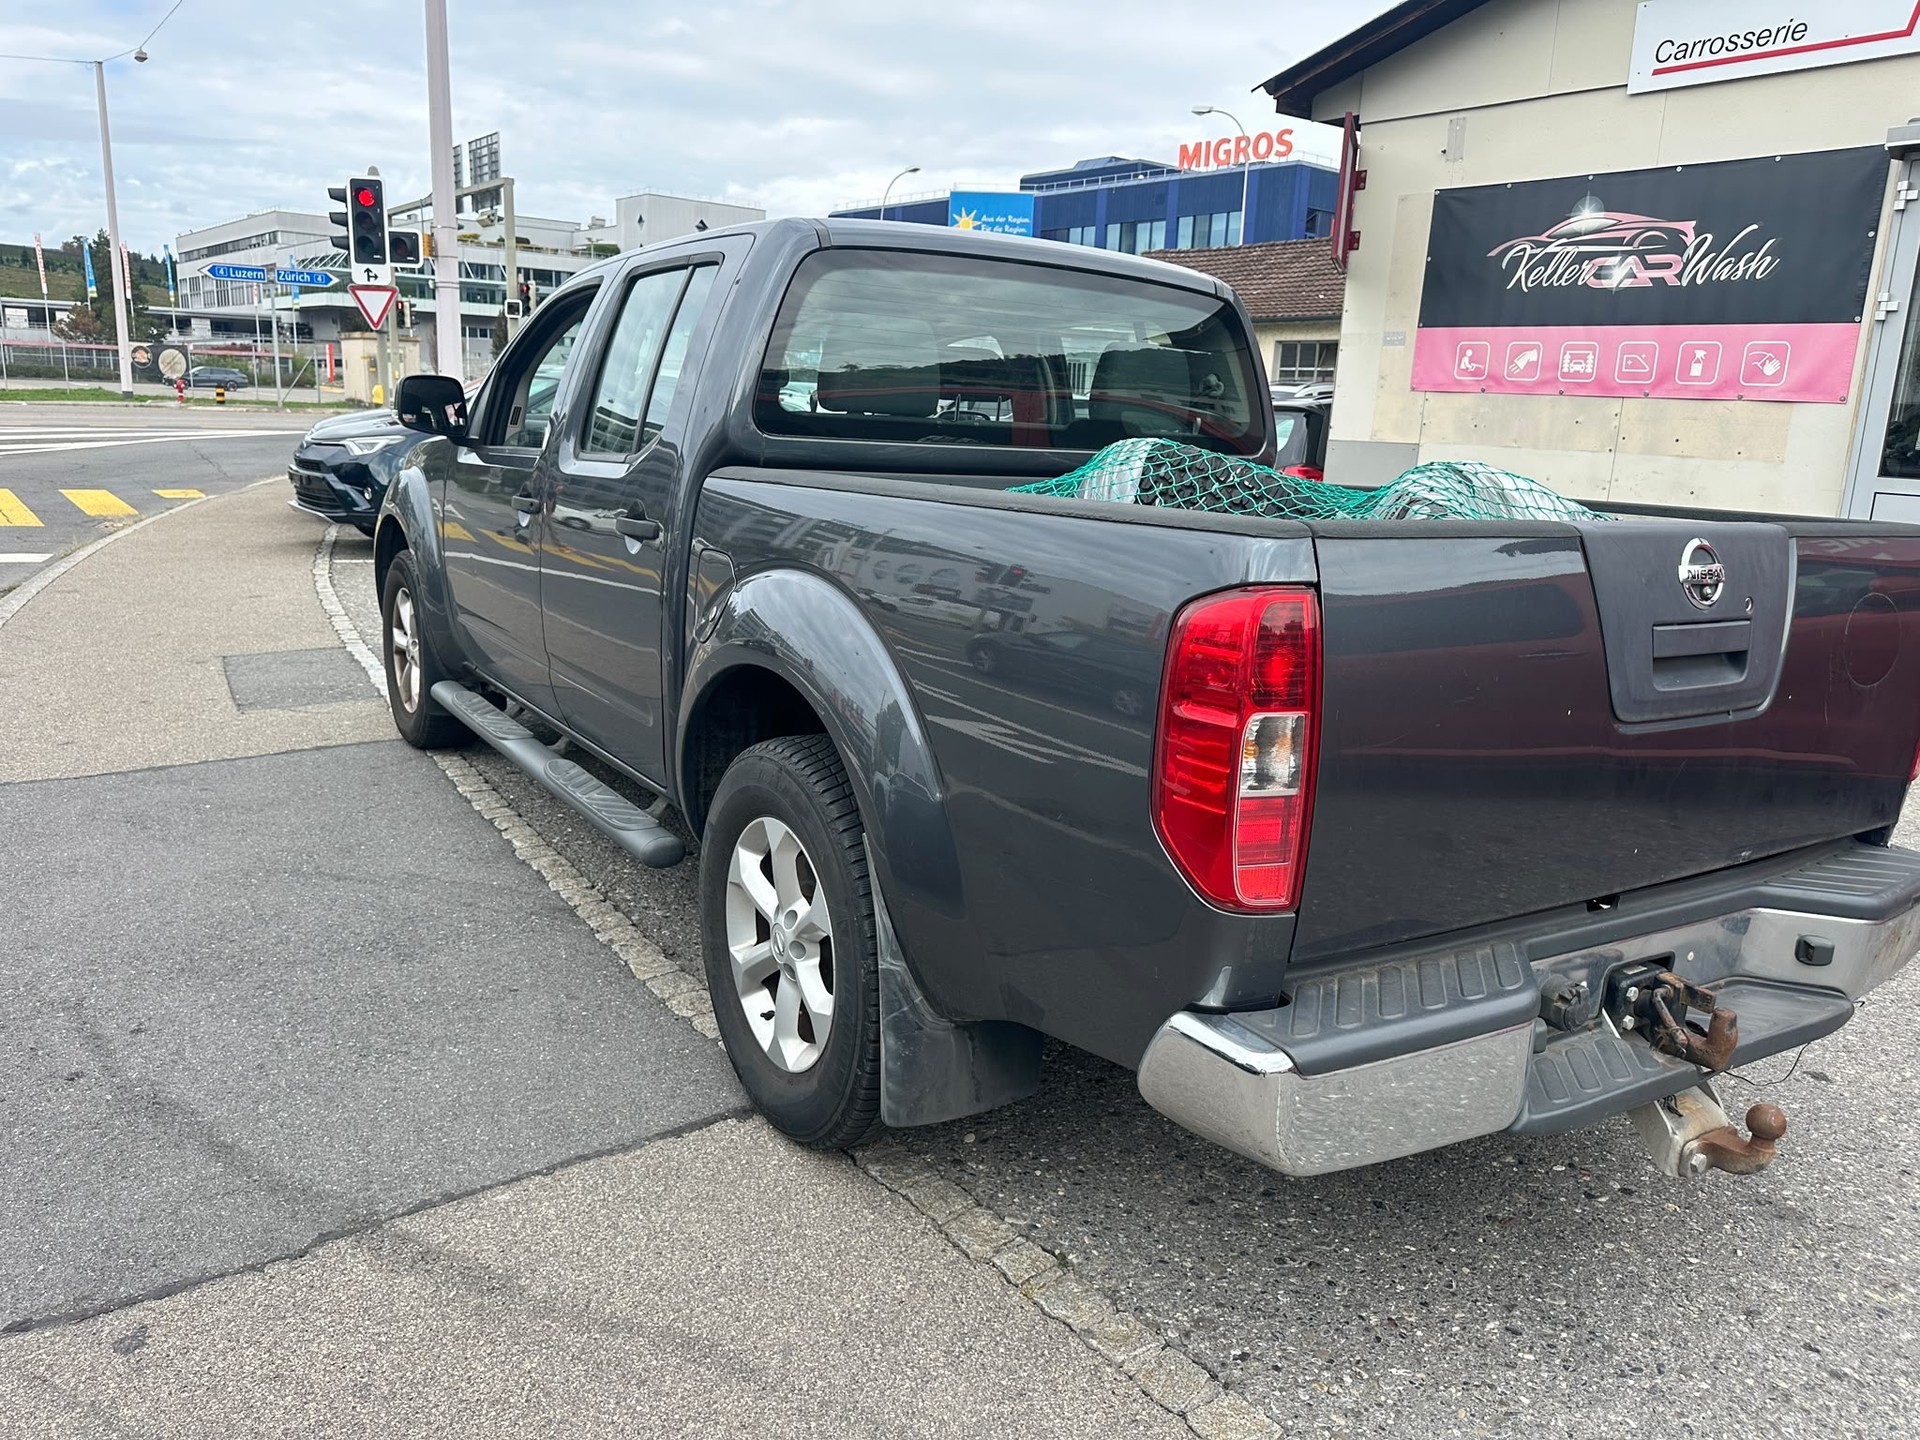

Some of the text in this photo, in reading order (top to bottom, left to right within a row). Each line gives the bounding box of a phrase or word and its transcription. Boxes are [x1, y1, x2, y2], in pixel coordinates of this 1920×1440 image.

[1655, 18, 1808, 64] Carrosserie
[1178, 128, 1294, 170] MIGROS
[229, 268, 264, 280] Luzern
[278, 270, 311, 283] Zürich
[1501, 224, 1781, 293] Keller CAR Wash
